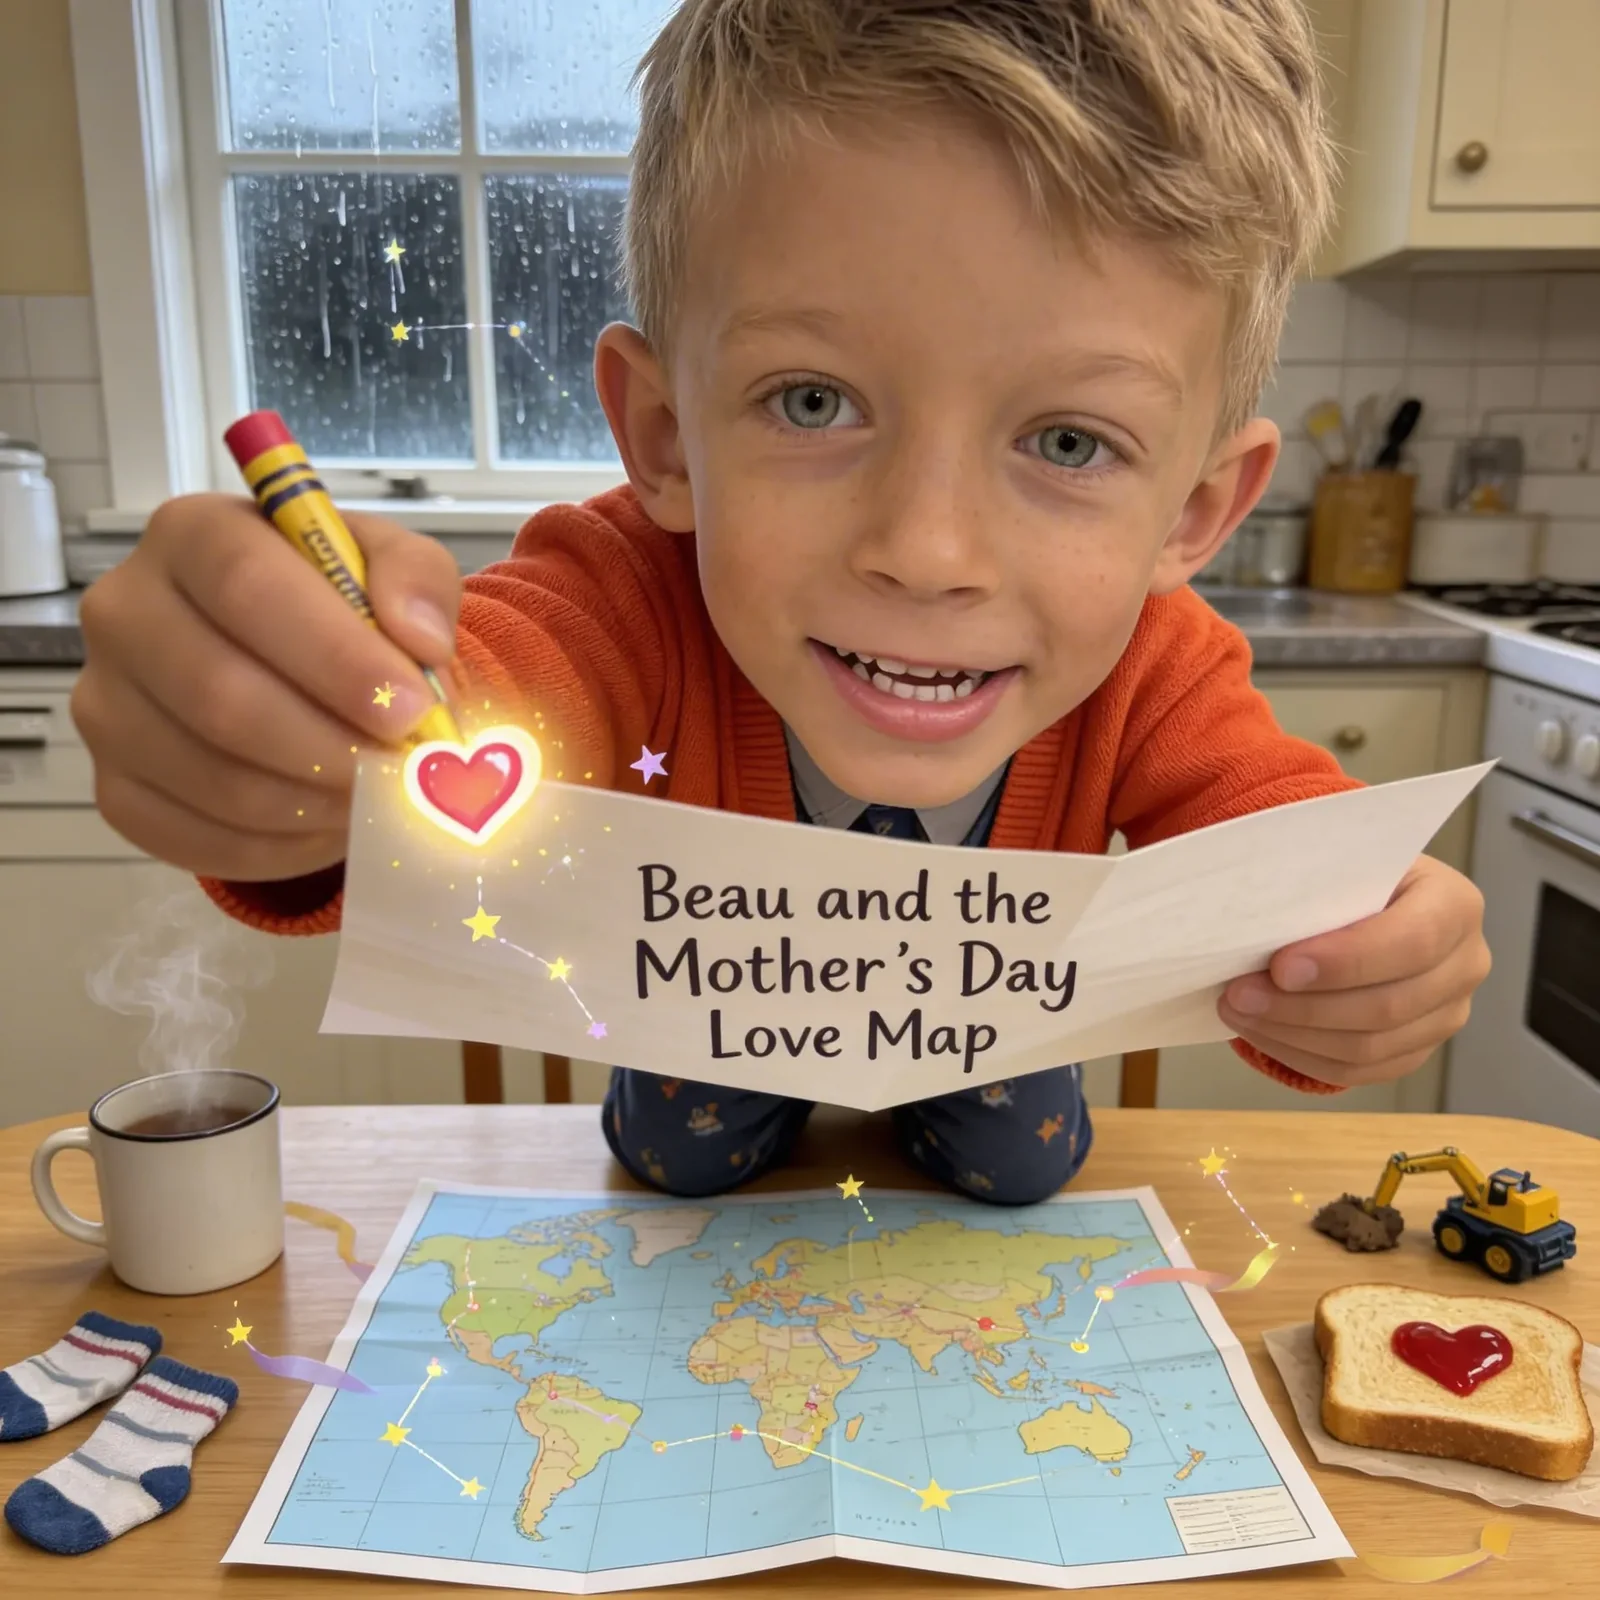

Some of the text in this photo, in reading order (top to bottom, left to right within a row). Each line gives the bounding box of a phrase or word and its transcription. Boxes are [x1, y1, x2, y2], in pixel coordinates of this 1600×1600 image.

[638, 864, 1051, 924] Beau and the
[636, 937, 1077, 1012] Mother’s Day
[711, 1009, 997, 1073] Love Map
